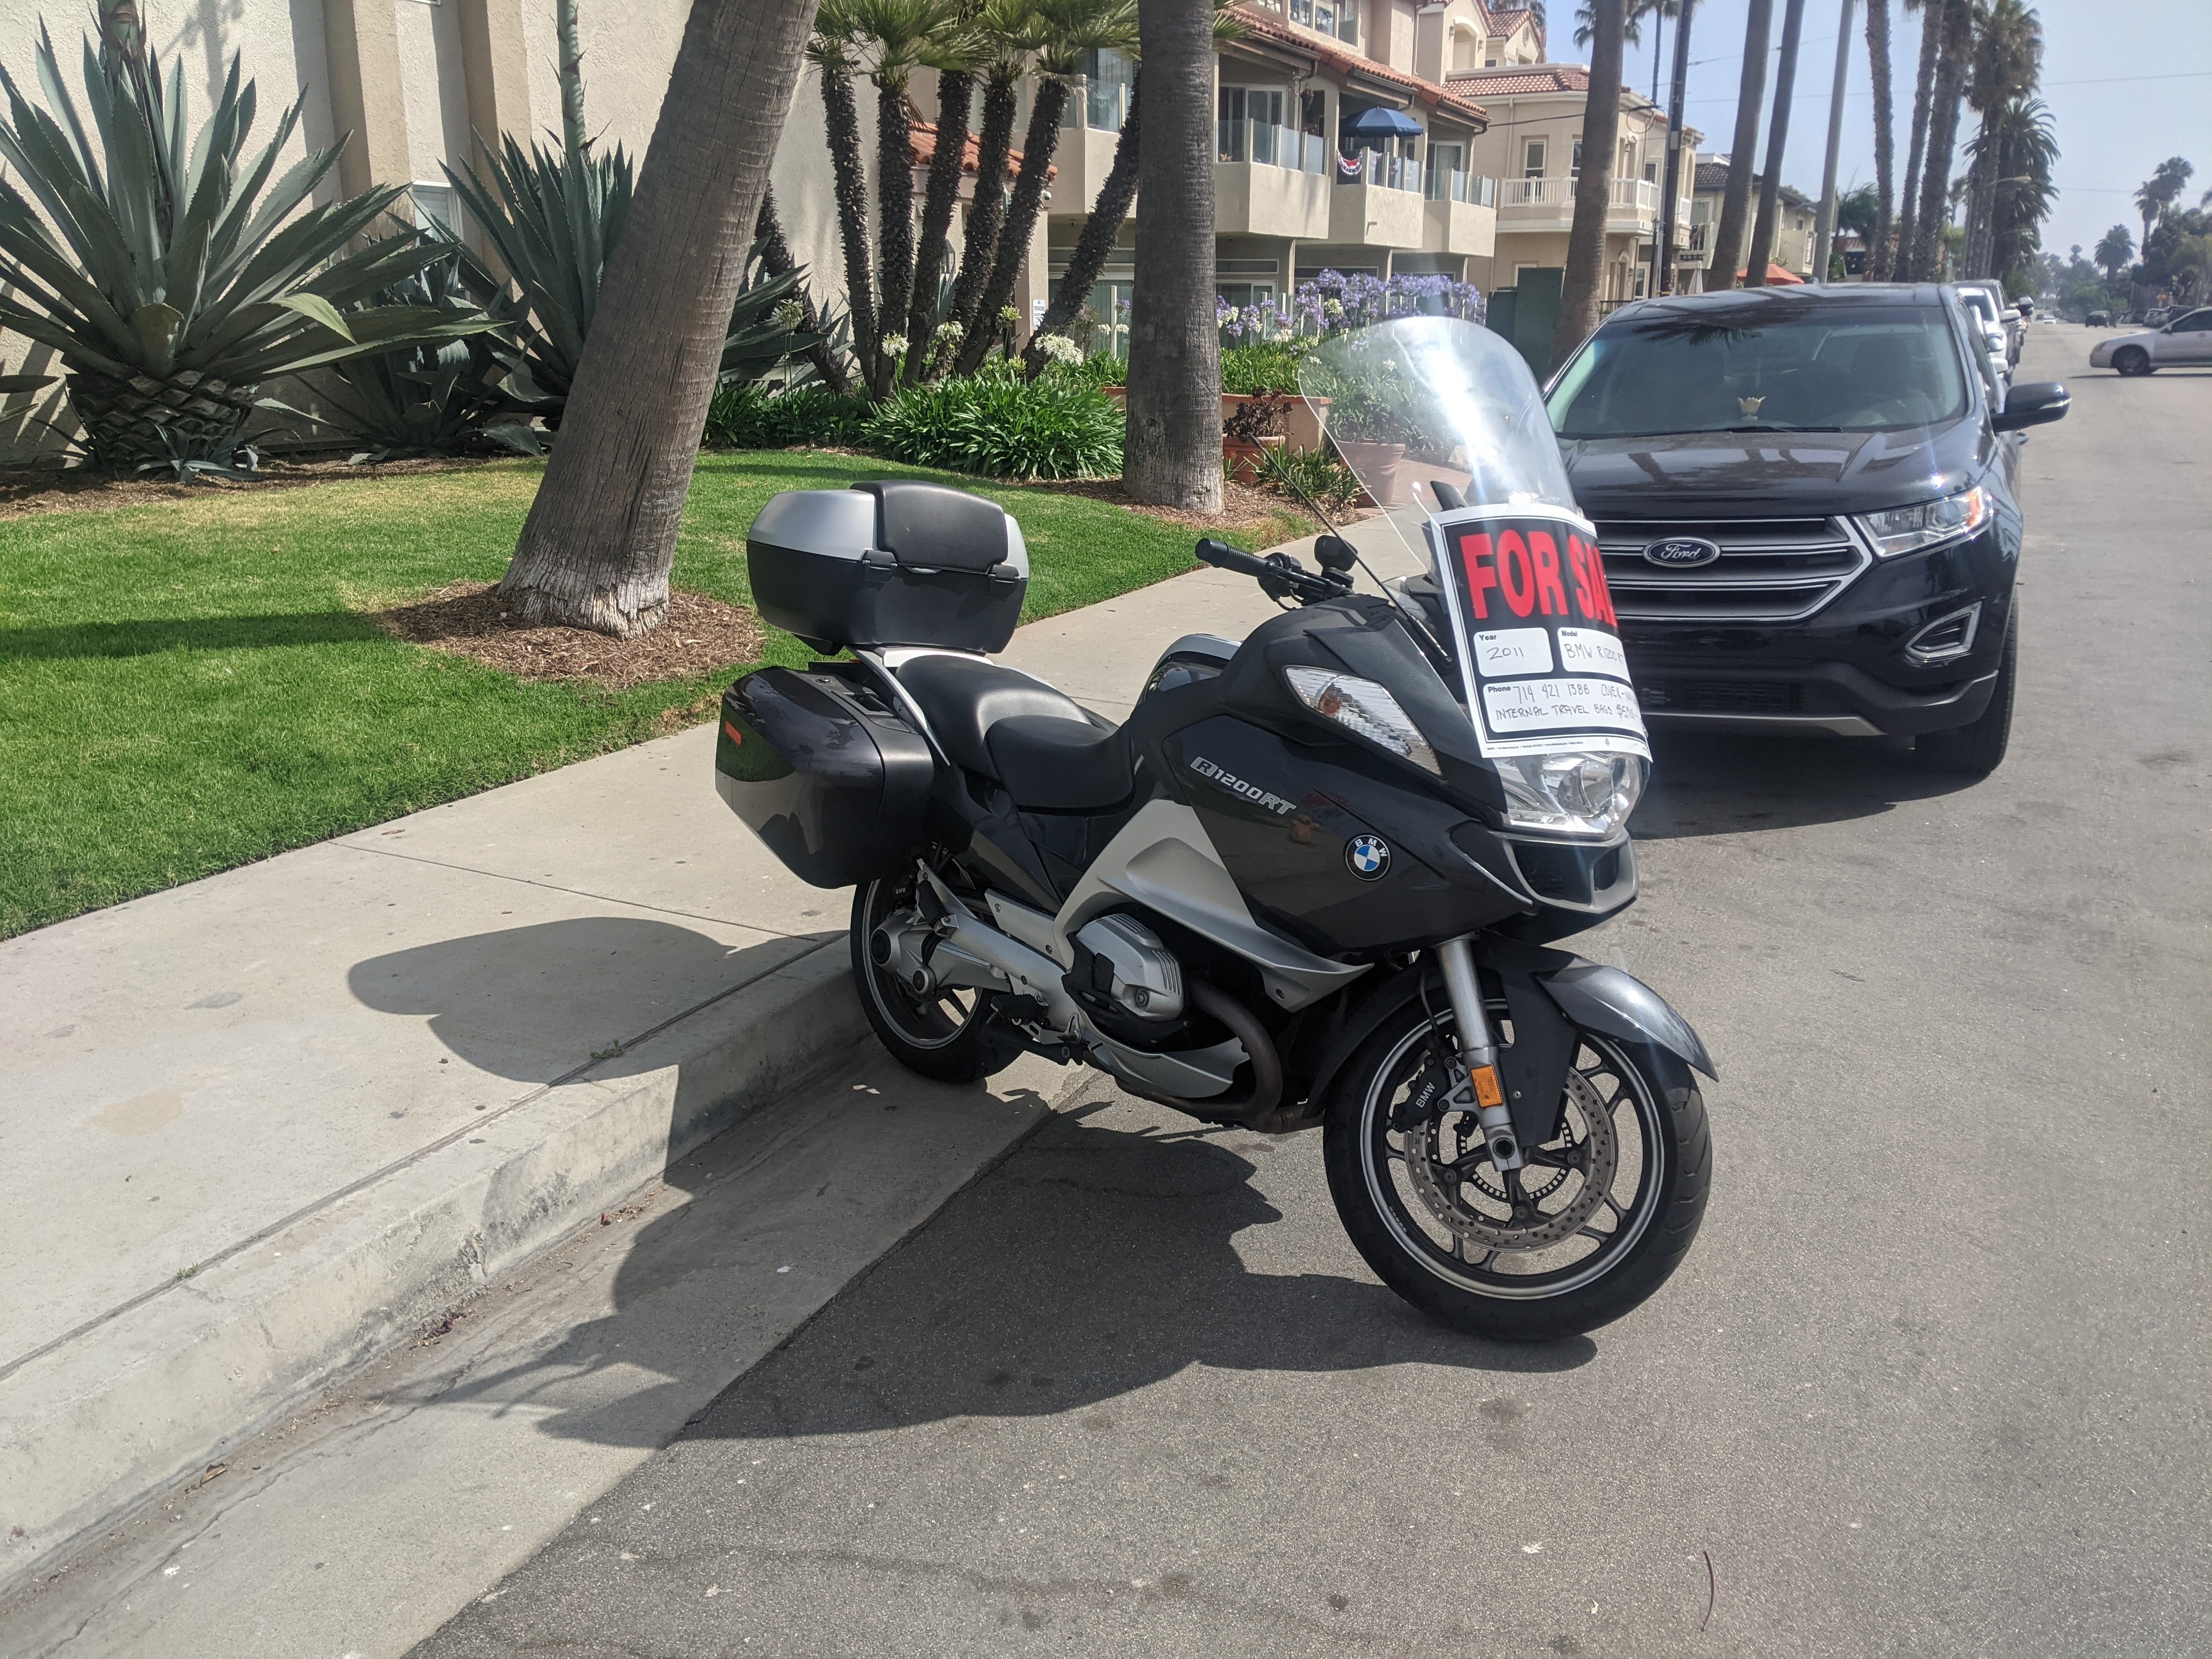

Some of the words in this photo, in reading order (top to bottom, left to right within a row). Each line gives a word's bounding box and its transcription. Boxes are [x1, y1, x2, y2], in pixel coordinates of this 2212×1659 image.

[1661, 544, 1702, 559] Ford
[1459, 529, 1568, 619] FOR
[1568, 534, 1618, 628] SAL
[1487, 647, 1524, 660] 2011
[1564, 644, 1592, 659] BMW
[1513, 685, 1535, 704] 714
[1542, 684, 1560, 699] 421
[1567, 684, 1589, 696] 1388
[1496, 706, 1549, 721] INTERNAL
[1551, 704, 1589, 715] TRAVEL
[1593, 704, 1612, 715] BAGS
[1190, 757, 1297, 815] R1200RT
[1355, 838, 1388, 857] BMW
[1415, 1082, 1435, 1108] BMW
